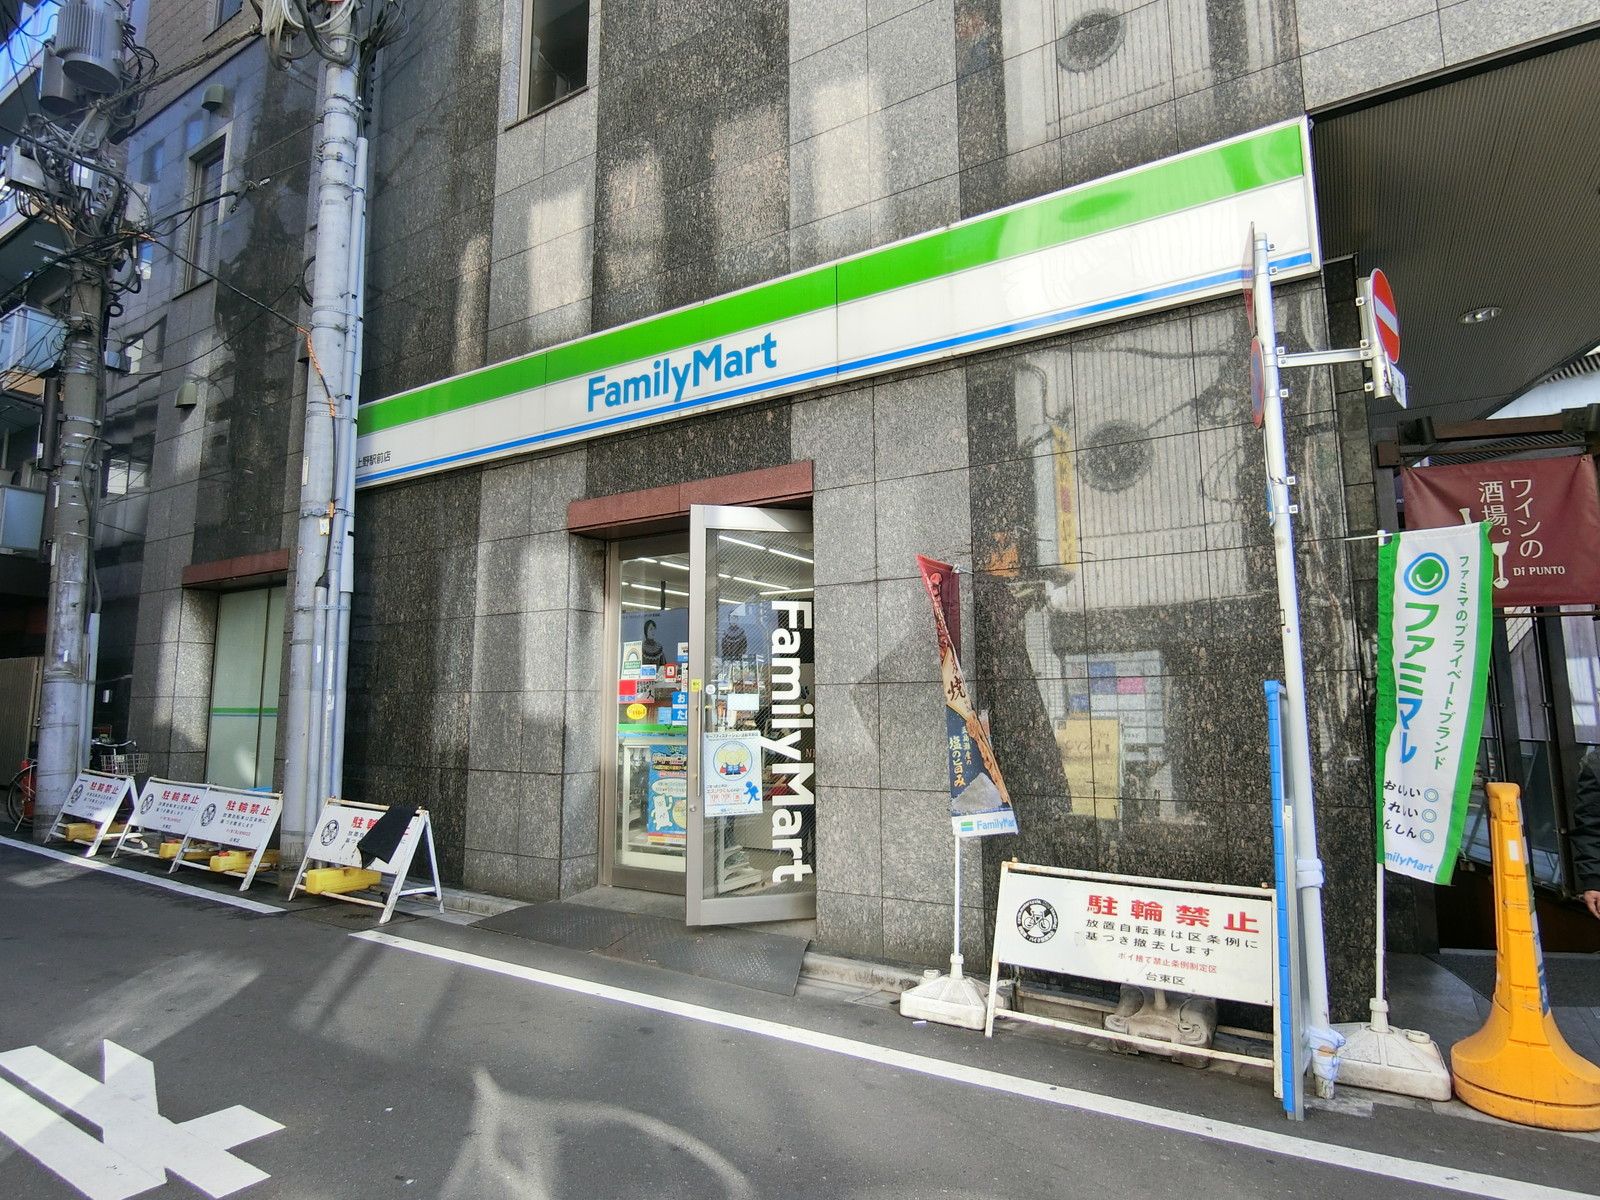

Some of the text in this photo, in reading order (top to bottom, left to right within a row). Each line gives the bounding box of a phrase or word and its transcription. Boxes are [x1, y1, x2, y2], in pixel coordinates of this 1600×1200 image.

[588, 332, 777, 413] FamilyMart
[356, 450, 391, 469] 上野駅前店
[1510, 478, 1543, 559] ワインの
[1529, 566, 1566, 575] PUNTO
[1434, 555, 1469, 770] ファミマのプライベートブランド
[760, 600, 815, 883] FamilyMart
[949, 735, 966, 787] 塩の旨み
[89, 781, 120, 795] 駐輪禁止
[162, 790, 200, 804] 駐輪禁止
[226, 800, 271, 816] 駐輪禁止
[976, 817, 1014, 831] FamilyMa
[1385, 852, 1434, 873] milyMart
[1086, 894, 1260, 934] 駐輪禁止
[1086, 918, 1259, 949] 放置自転車は区条例に
[1086, 931, 1215, 957] 基づき撤去します
[1146, 971, 1186, 986] 台東区
